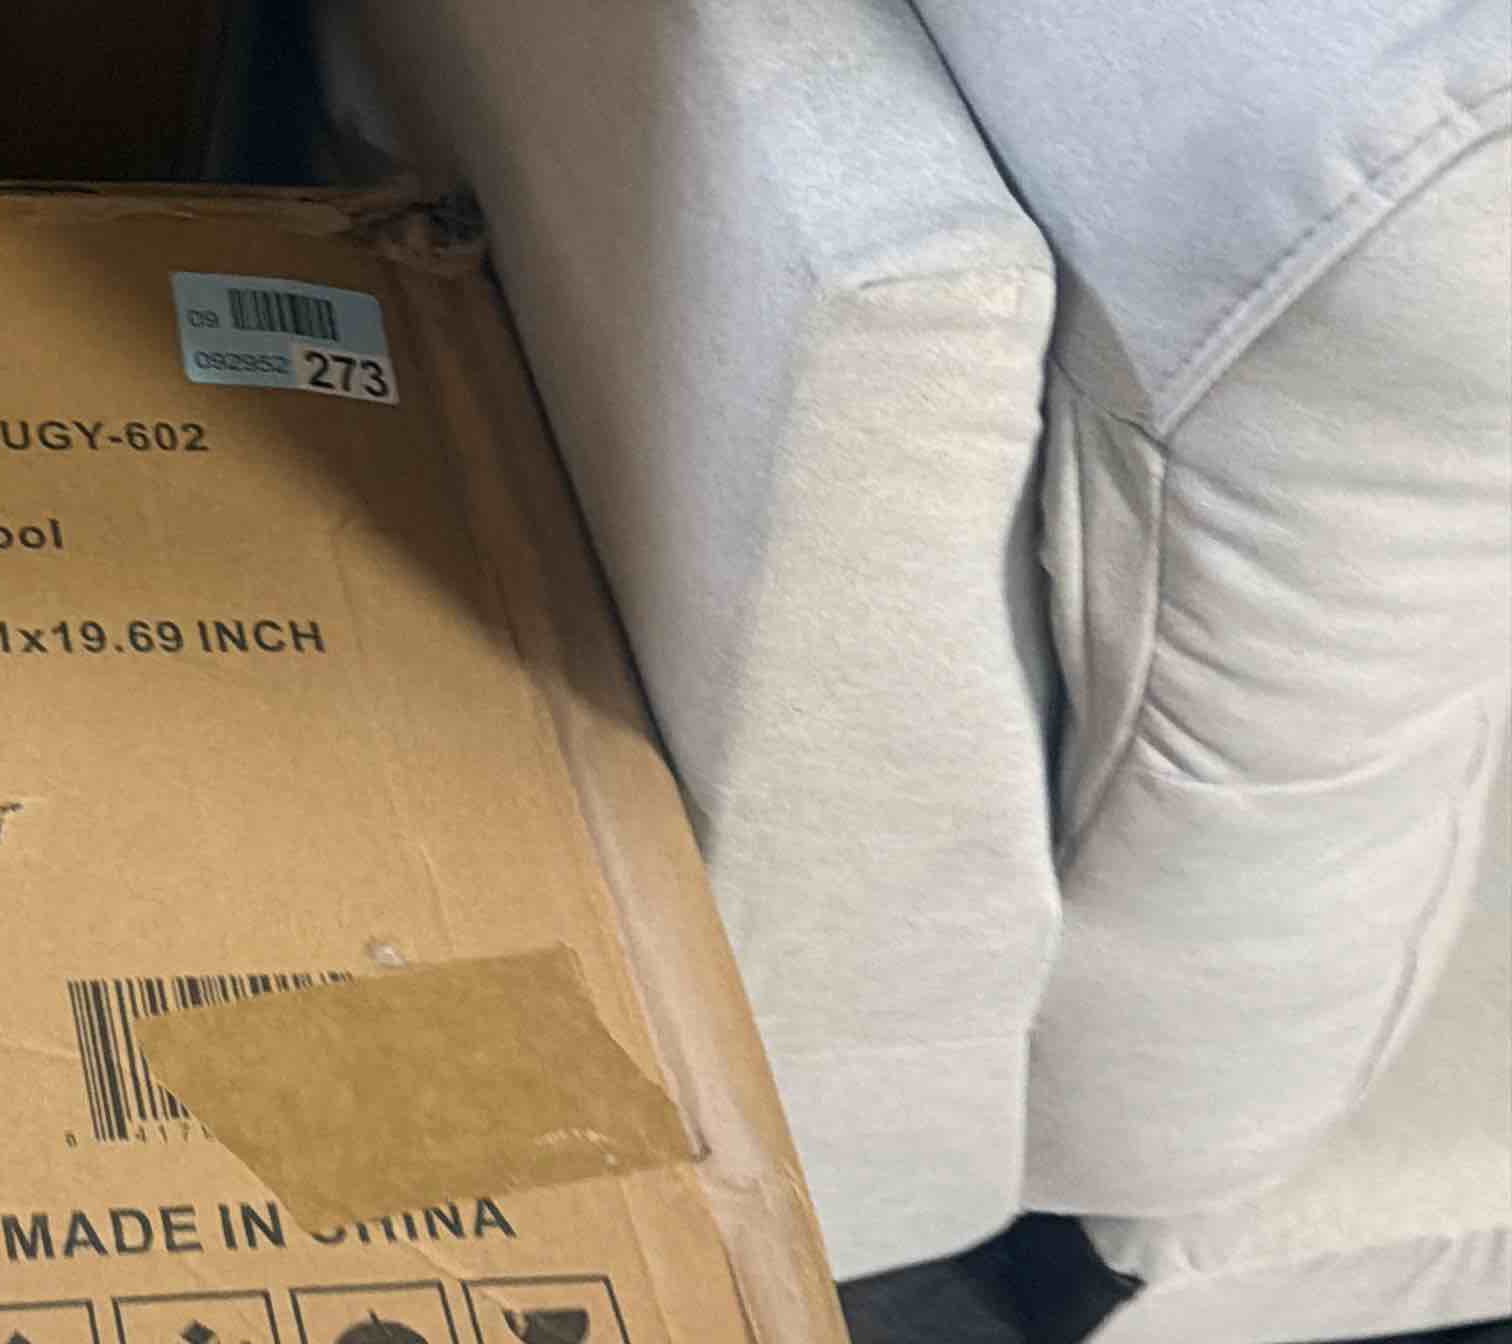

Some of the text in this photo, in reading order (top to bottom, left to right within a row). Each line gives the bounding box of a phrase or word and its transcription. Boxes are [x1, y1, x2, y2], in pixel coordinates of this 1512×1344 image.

[303, 349, 389, 398] 273
[196, 619, 326, 654] INCH
[0, 1205, 204, 1263] MADE
[218, 1200, 287, 1251] IN
